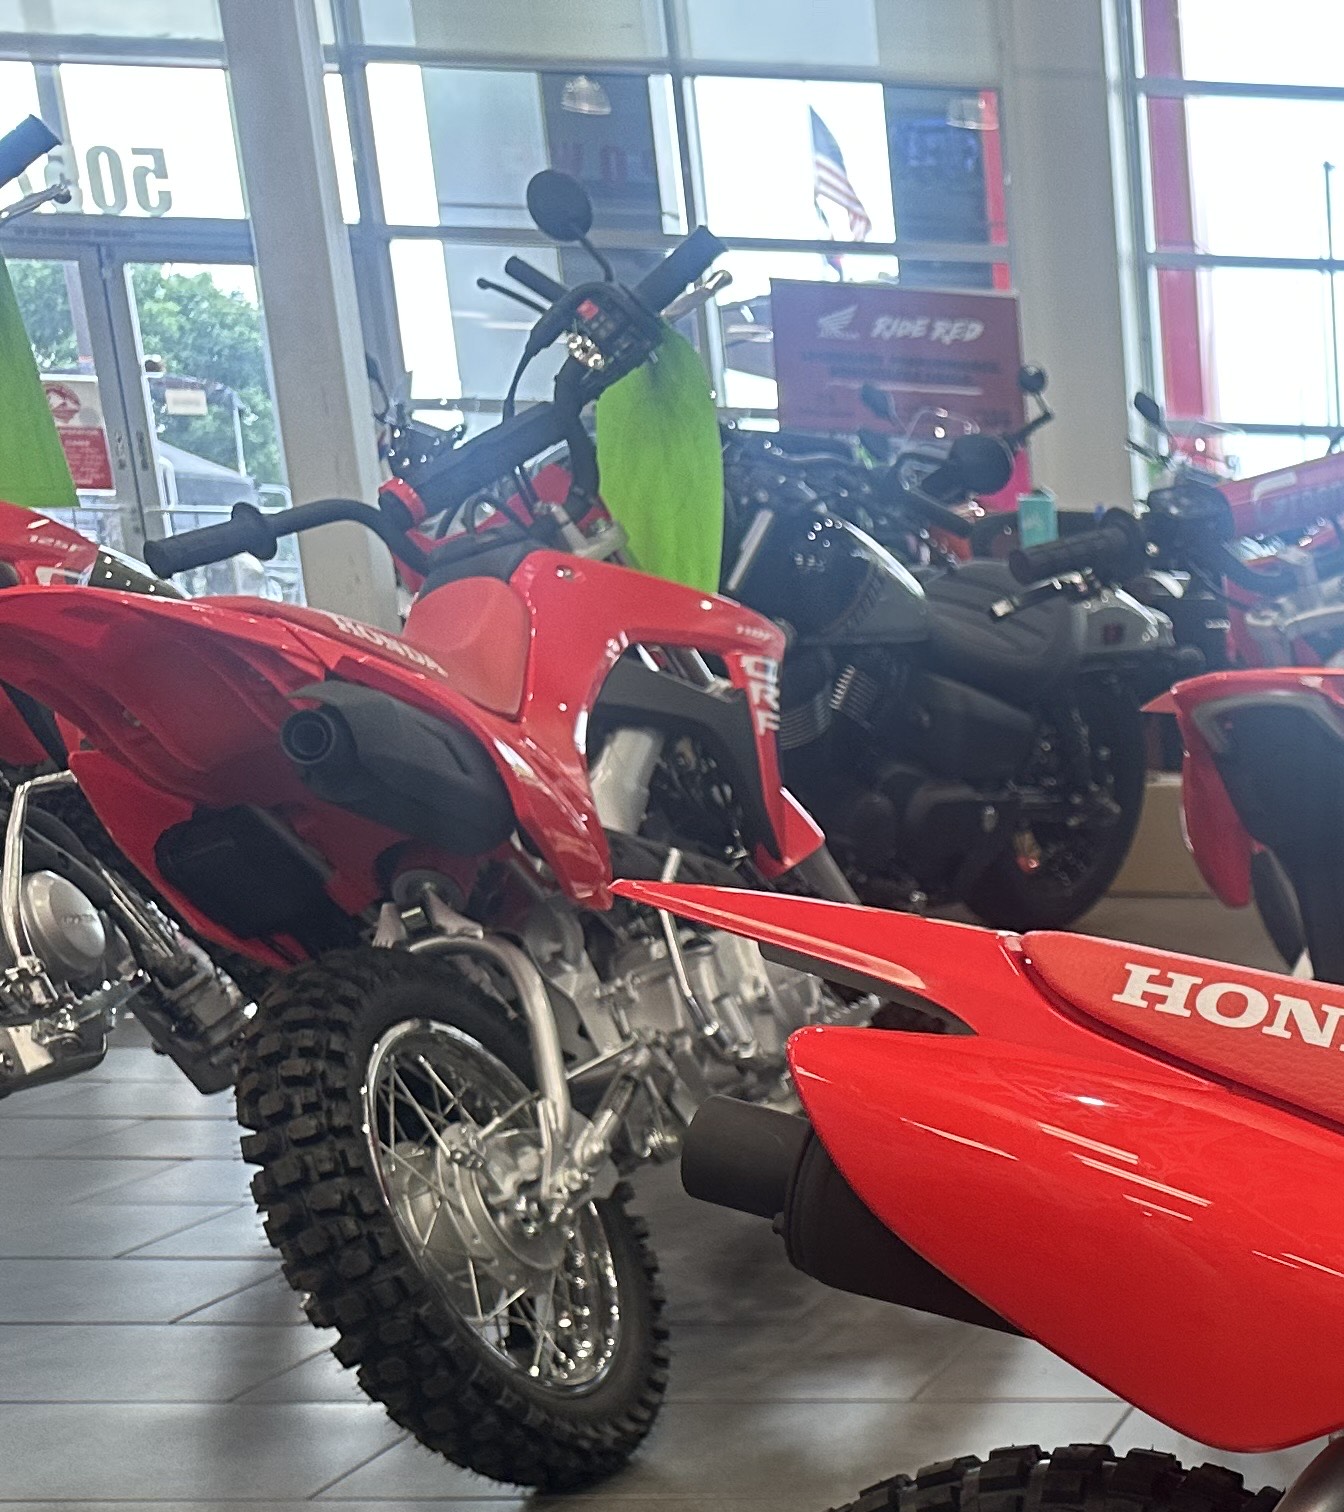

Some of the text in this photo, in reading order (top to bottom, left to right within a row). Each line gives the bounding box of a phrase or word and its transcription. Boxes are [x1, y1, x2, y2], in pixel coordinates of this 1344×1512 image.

[871, 314, 985, 345] RIDE RED
[332, 615, 449, 678] HONDA
